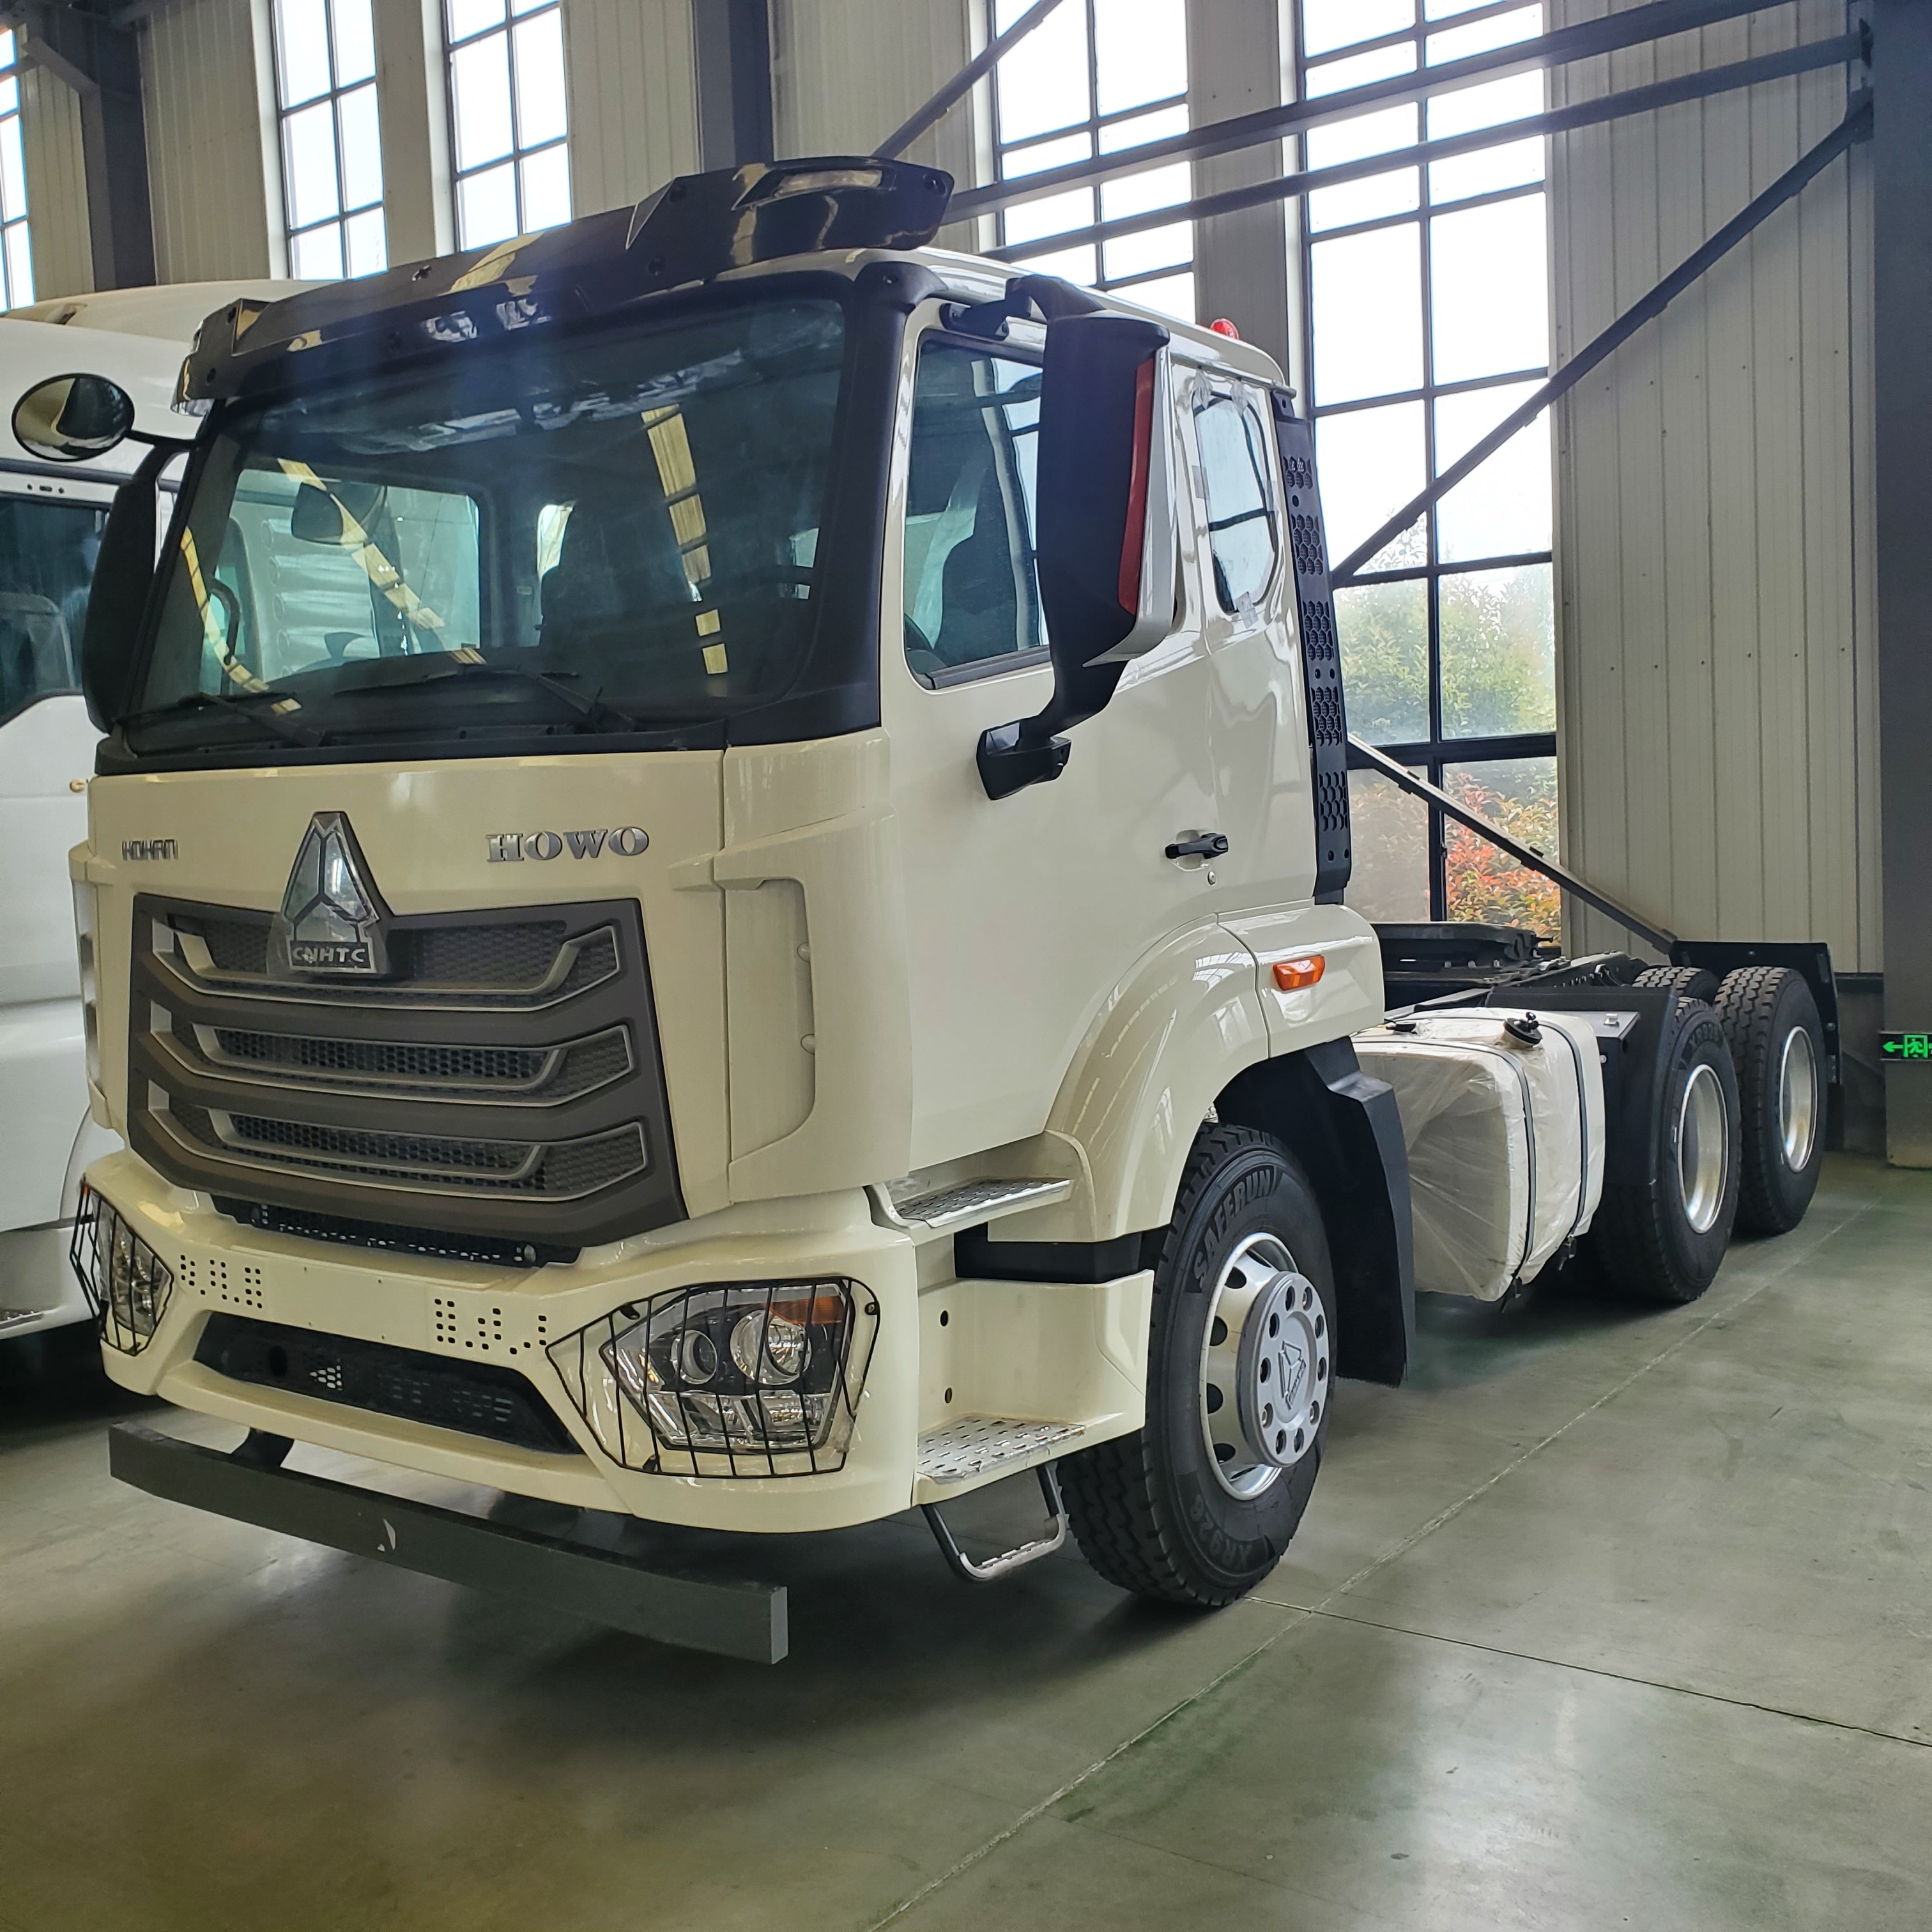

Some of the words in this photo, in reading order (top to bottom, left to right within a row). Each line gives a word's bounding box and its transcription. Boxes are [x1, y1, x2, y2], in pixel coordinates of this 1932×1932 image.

[121, 839, 178, 861] HOHAN
[485, 826, 649, 862] HOWO
[293, 947, 365, 963] CNHTC
[1194, 1169, 1271, 1289] SAFERUN
